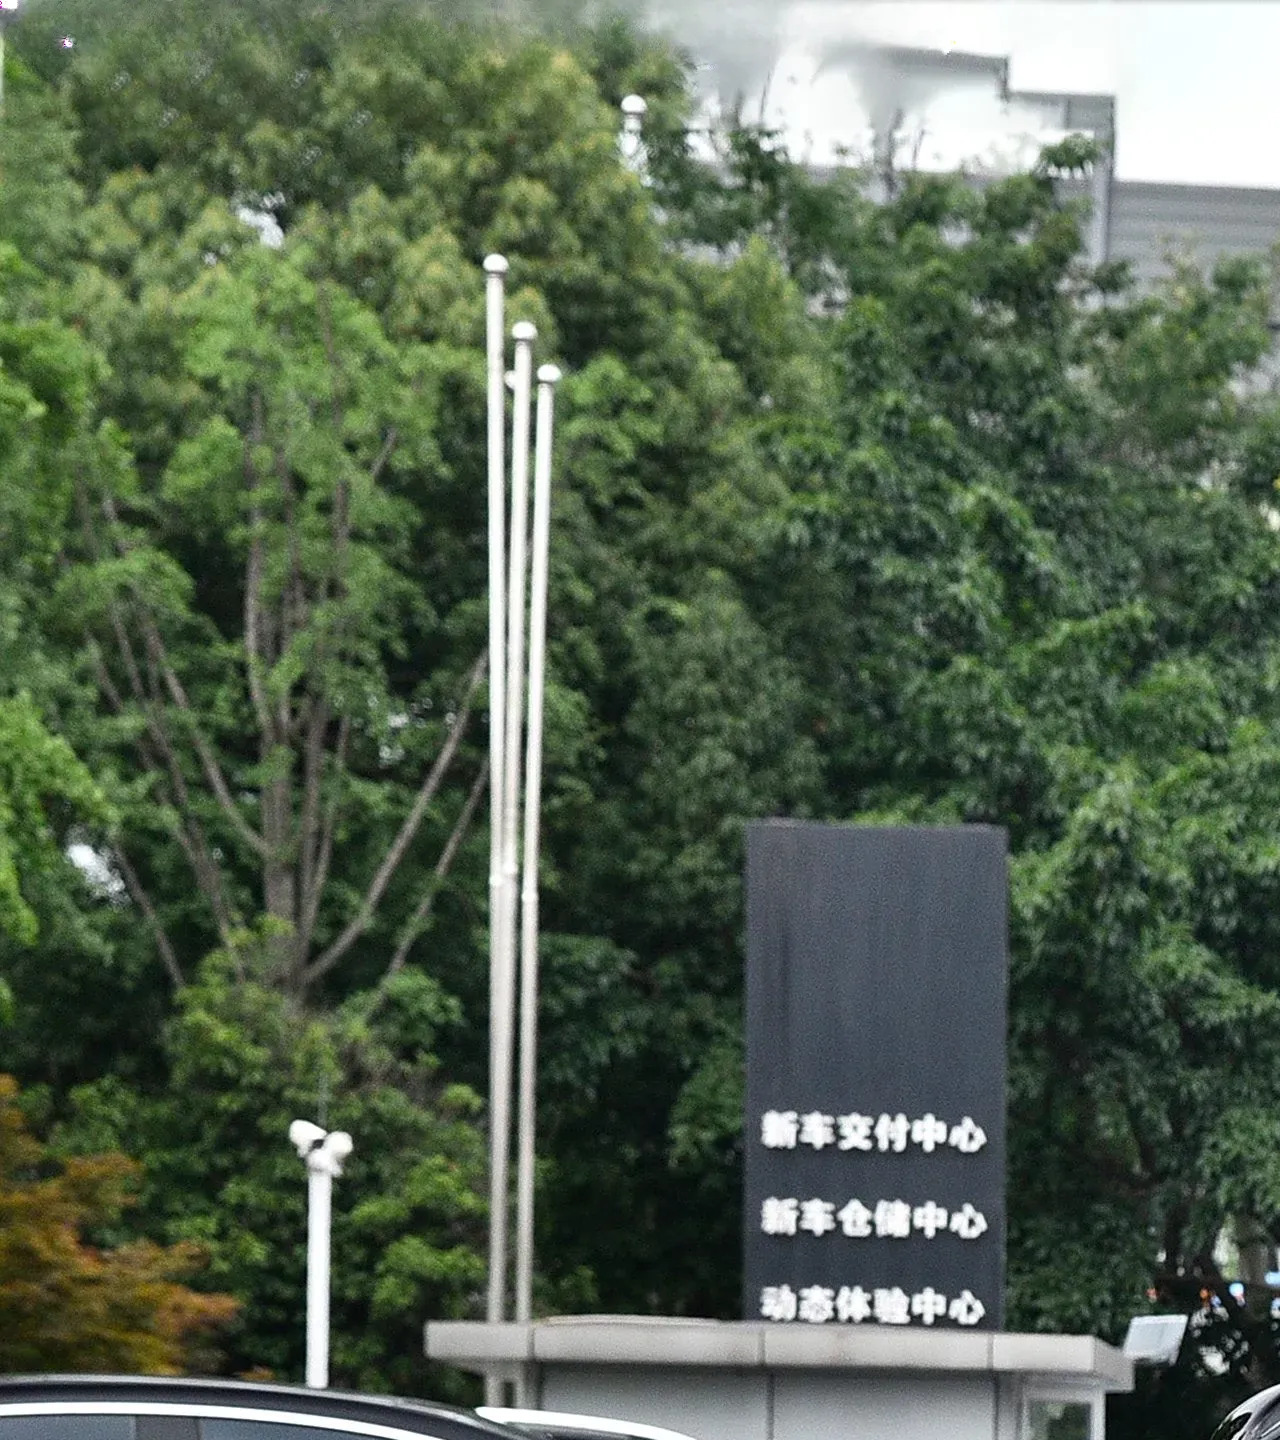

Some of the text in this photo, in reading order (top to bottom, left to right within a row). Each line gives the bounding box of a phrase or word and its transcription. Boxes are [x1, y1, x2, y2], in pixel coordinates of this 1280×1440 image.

[762, 1197, 987, 1238] 新车仓储中心
[761, 1284, 985, 1324] 动态体验中心
